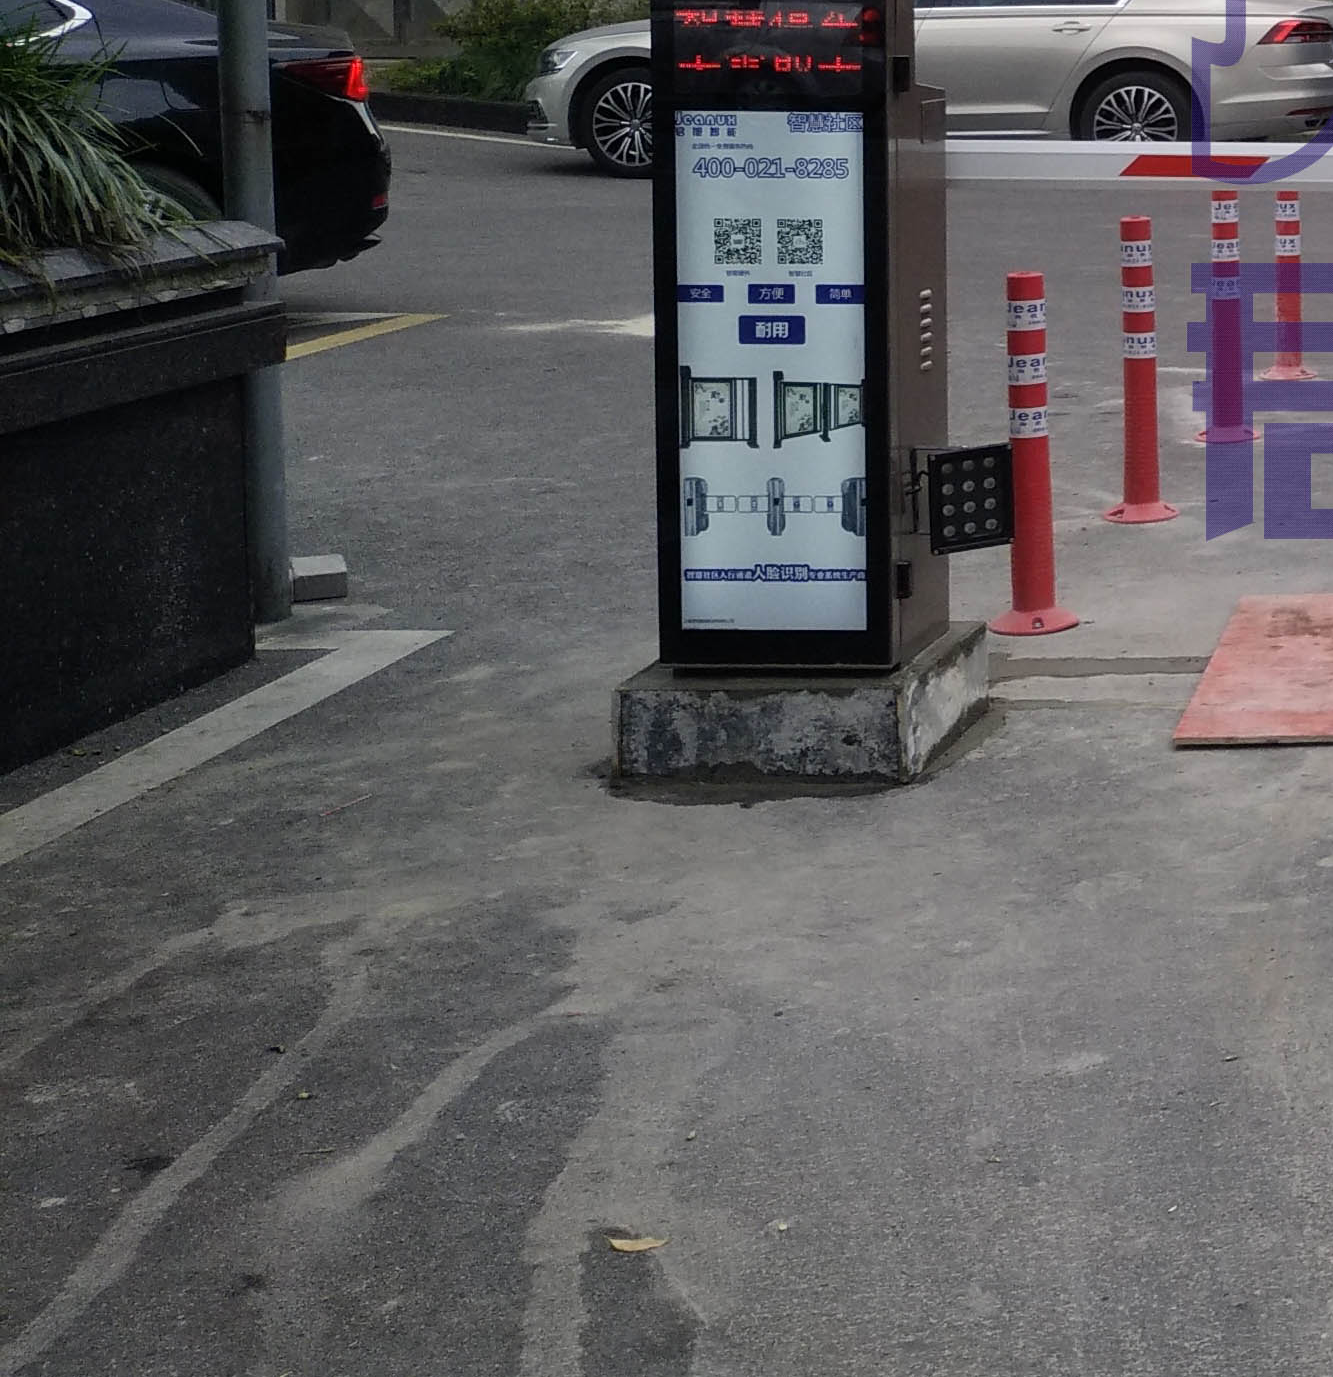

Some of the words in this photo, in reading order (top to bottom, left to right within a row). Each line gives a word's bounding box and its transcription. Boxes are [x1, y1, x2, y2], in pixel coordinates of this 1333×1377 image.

[787, 112, 863, 134] 智慧社区
[693, 157, 849, 179] 400-021-8285
[689, 288, 712, 299] 安全
[759, 287, 785, 300] 方便
[829, 287, 853, 300] 简单
[755, 320, 789, 340] 耐用
